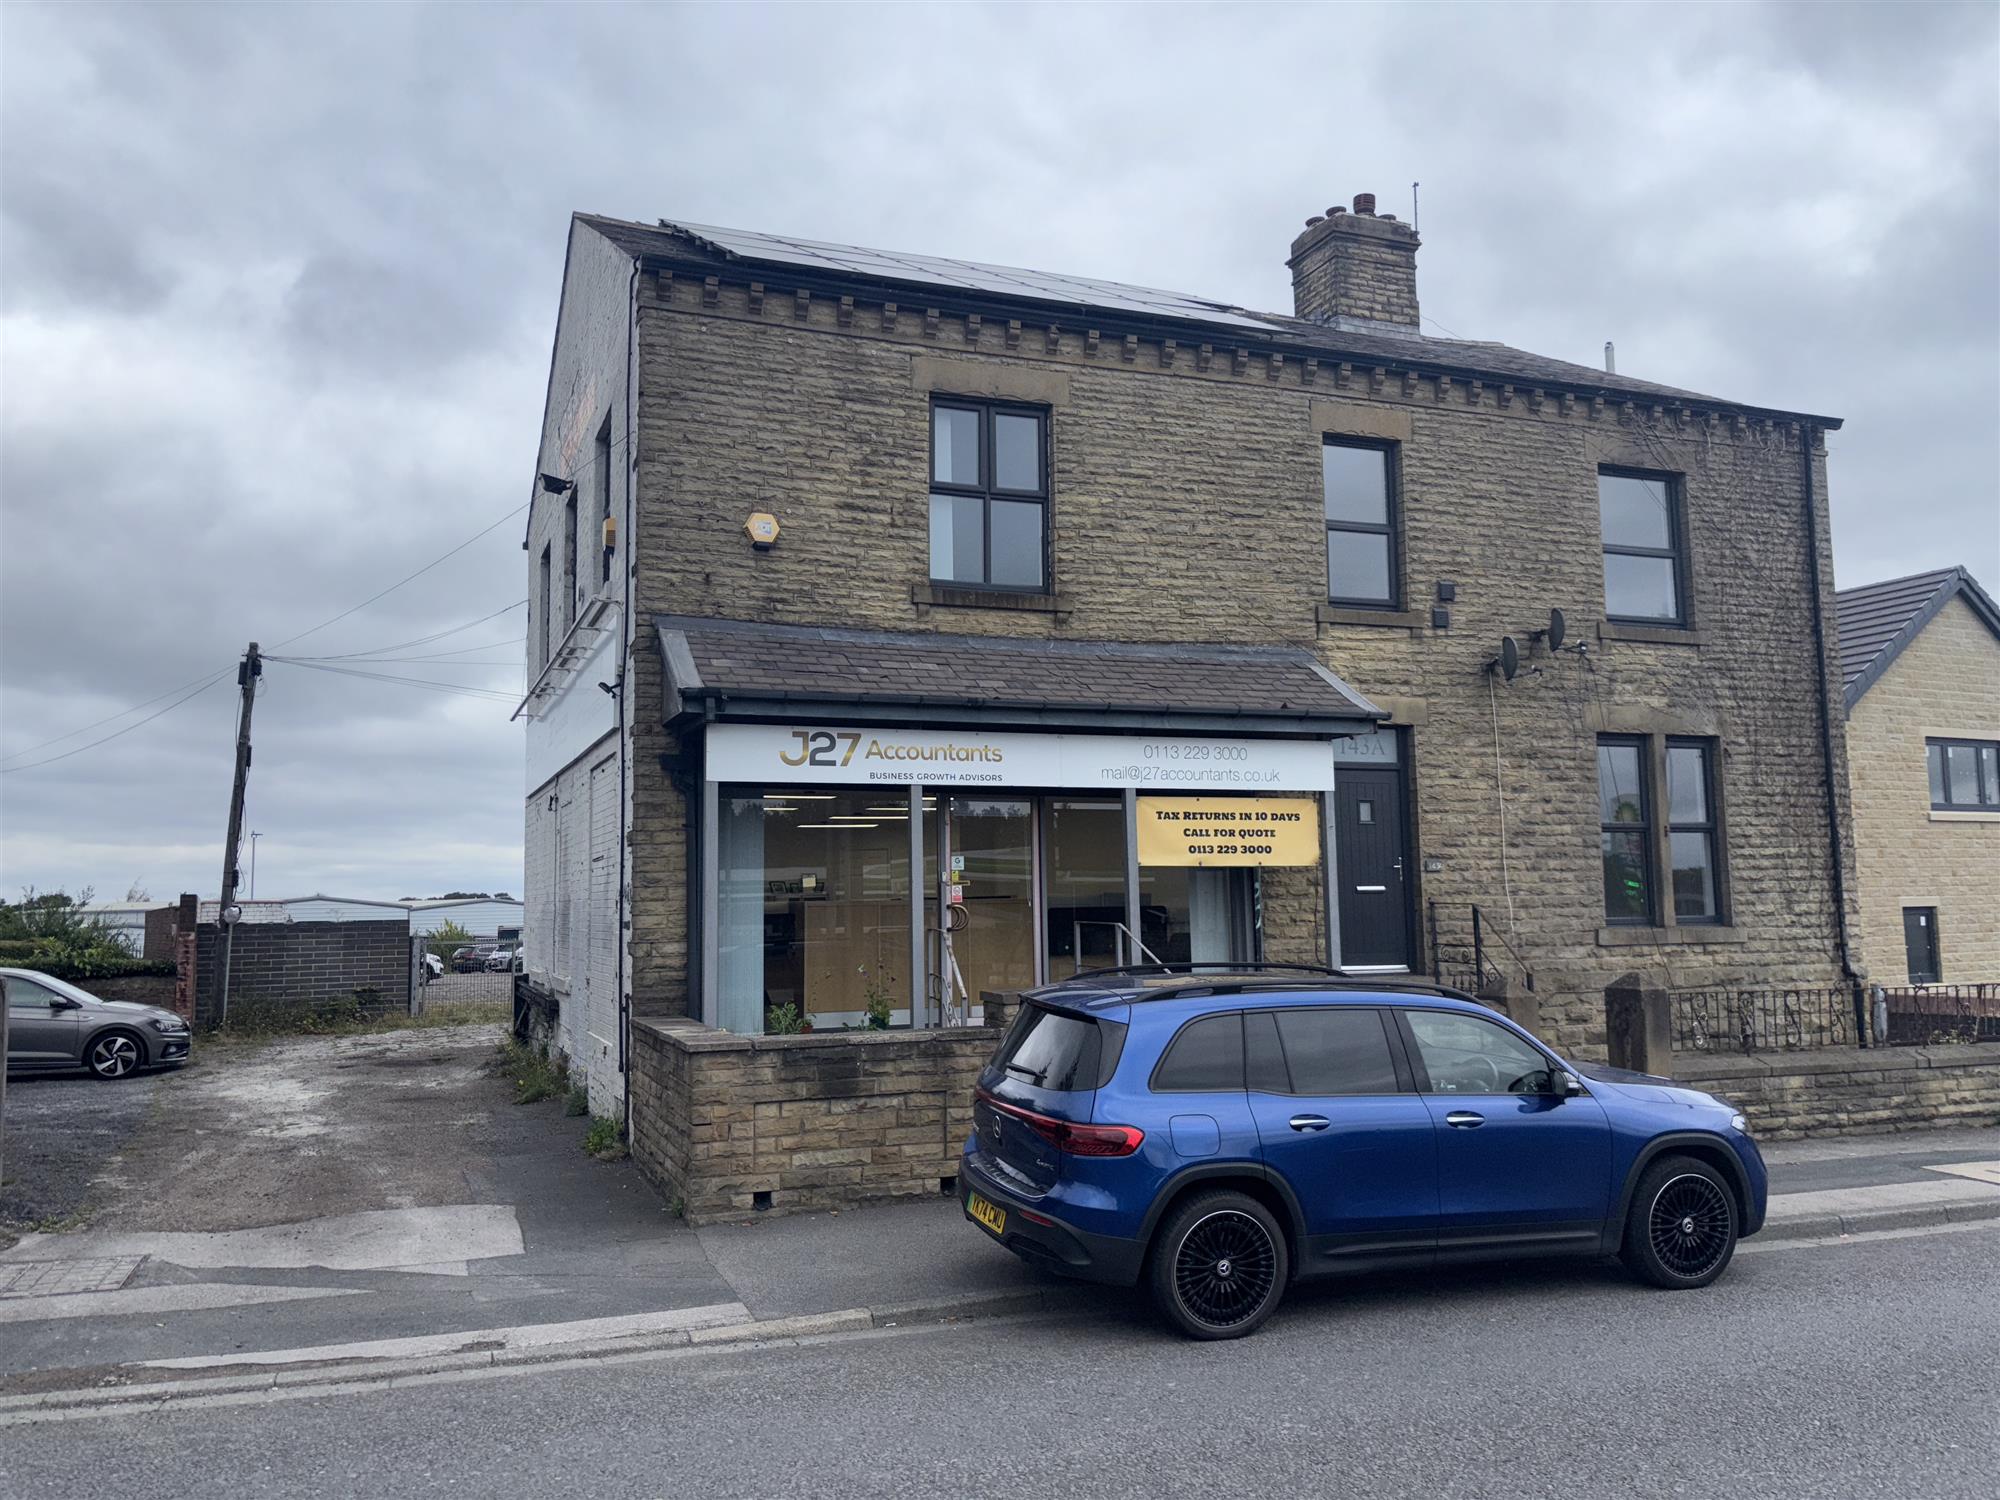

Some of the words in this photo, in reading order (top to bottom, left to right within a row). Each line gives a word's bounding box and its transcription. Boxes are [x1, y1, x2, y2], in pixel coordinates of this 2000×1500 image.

[779, 731, 862, 767] J27
[865, 739, 1003, 763] Accountants
[1143, 744, 1180, 760] 0113
[1184, 745, 1210, 761] 229
[1213, 746, 1248, 761] 3000
[869, 771, 914, 781] BUSINESS
[917, 772, 956, 782] GROWTH
[959, 773, 1003, 783] ADVISORS
[1101, 765, 1281, 783] mail@j27accountants.co.uk
[1156, 810, 1180, 821] TAX
[1183, 811, 1236, 821] RETURNS
[1239, 812, 1253, 821] IN
[1256, 812, 1268, 821] 10
[1270, 812, 1301, 822] DAYS
[1183, 828, 1211, 838] CALL
[1213, 828, 1236, 838] FOR
[1238, 829, 1276, 839] QUOTE
[1188, 845, 1214, 854] 0113
[1217, 845, 1238, 854] 229
[1240, 845, 1272, 854] 3000
